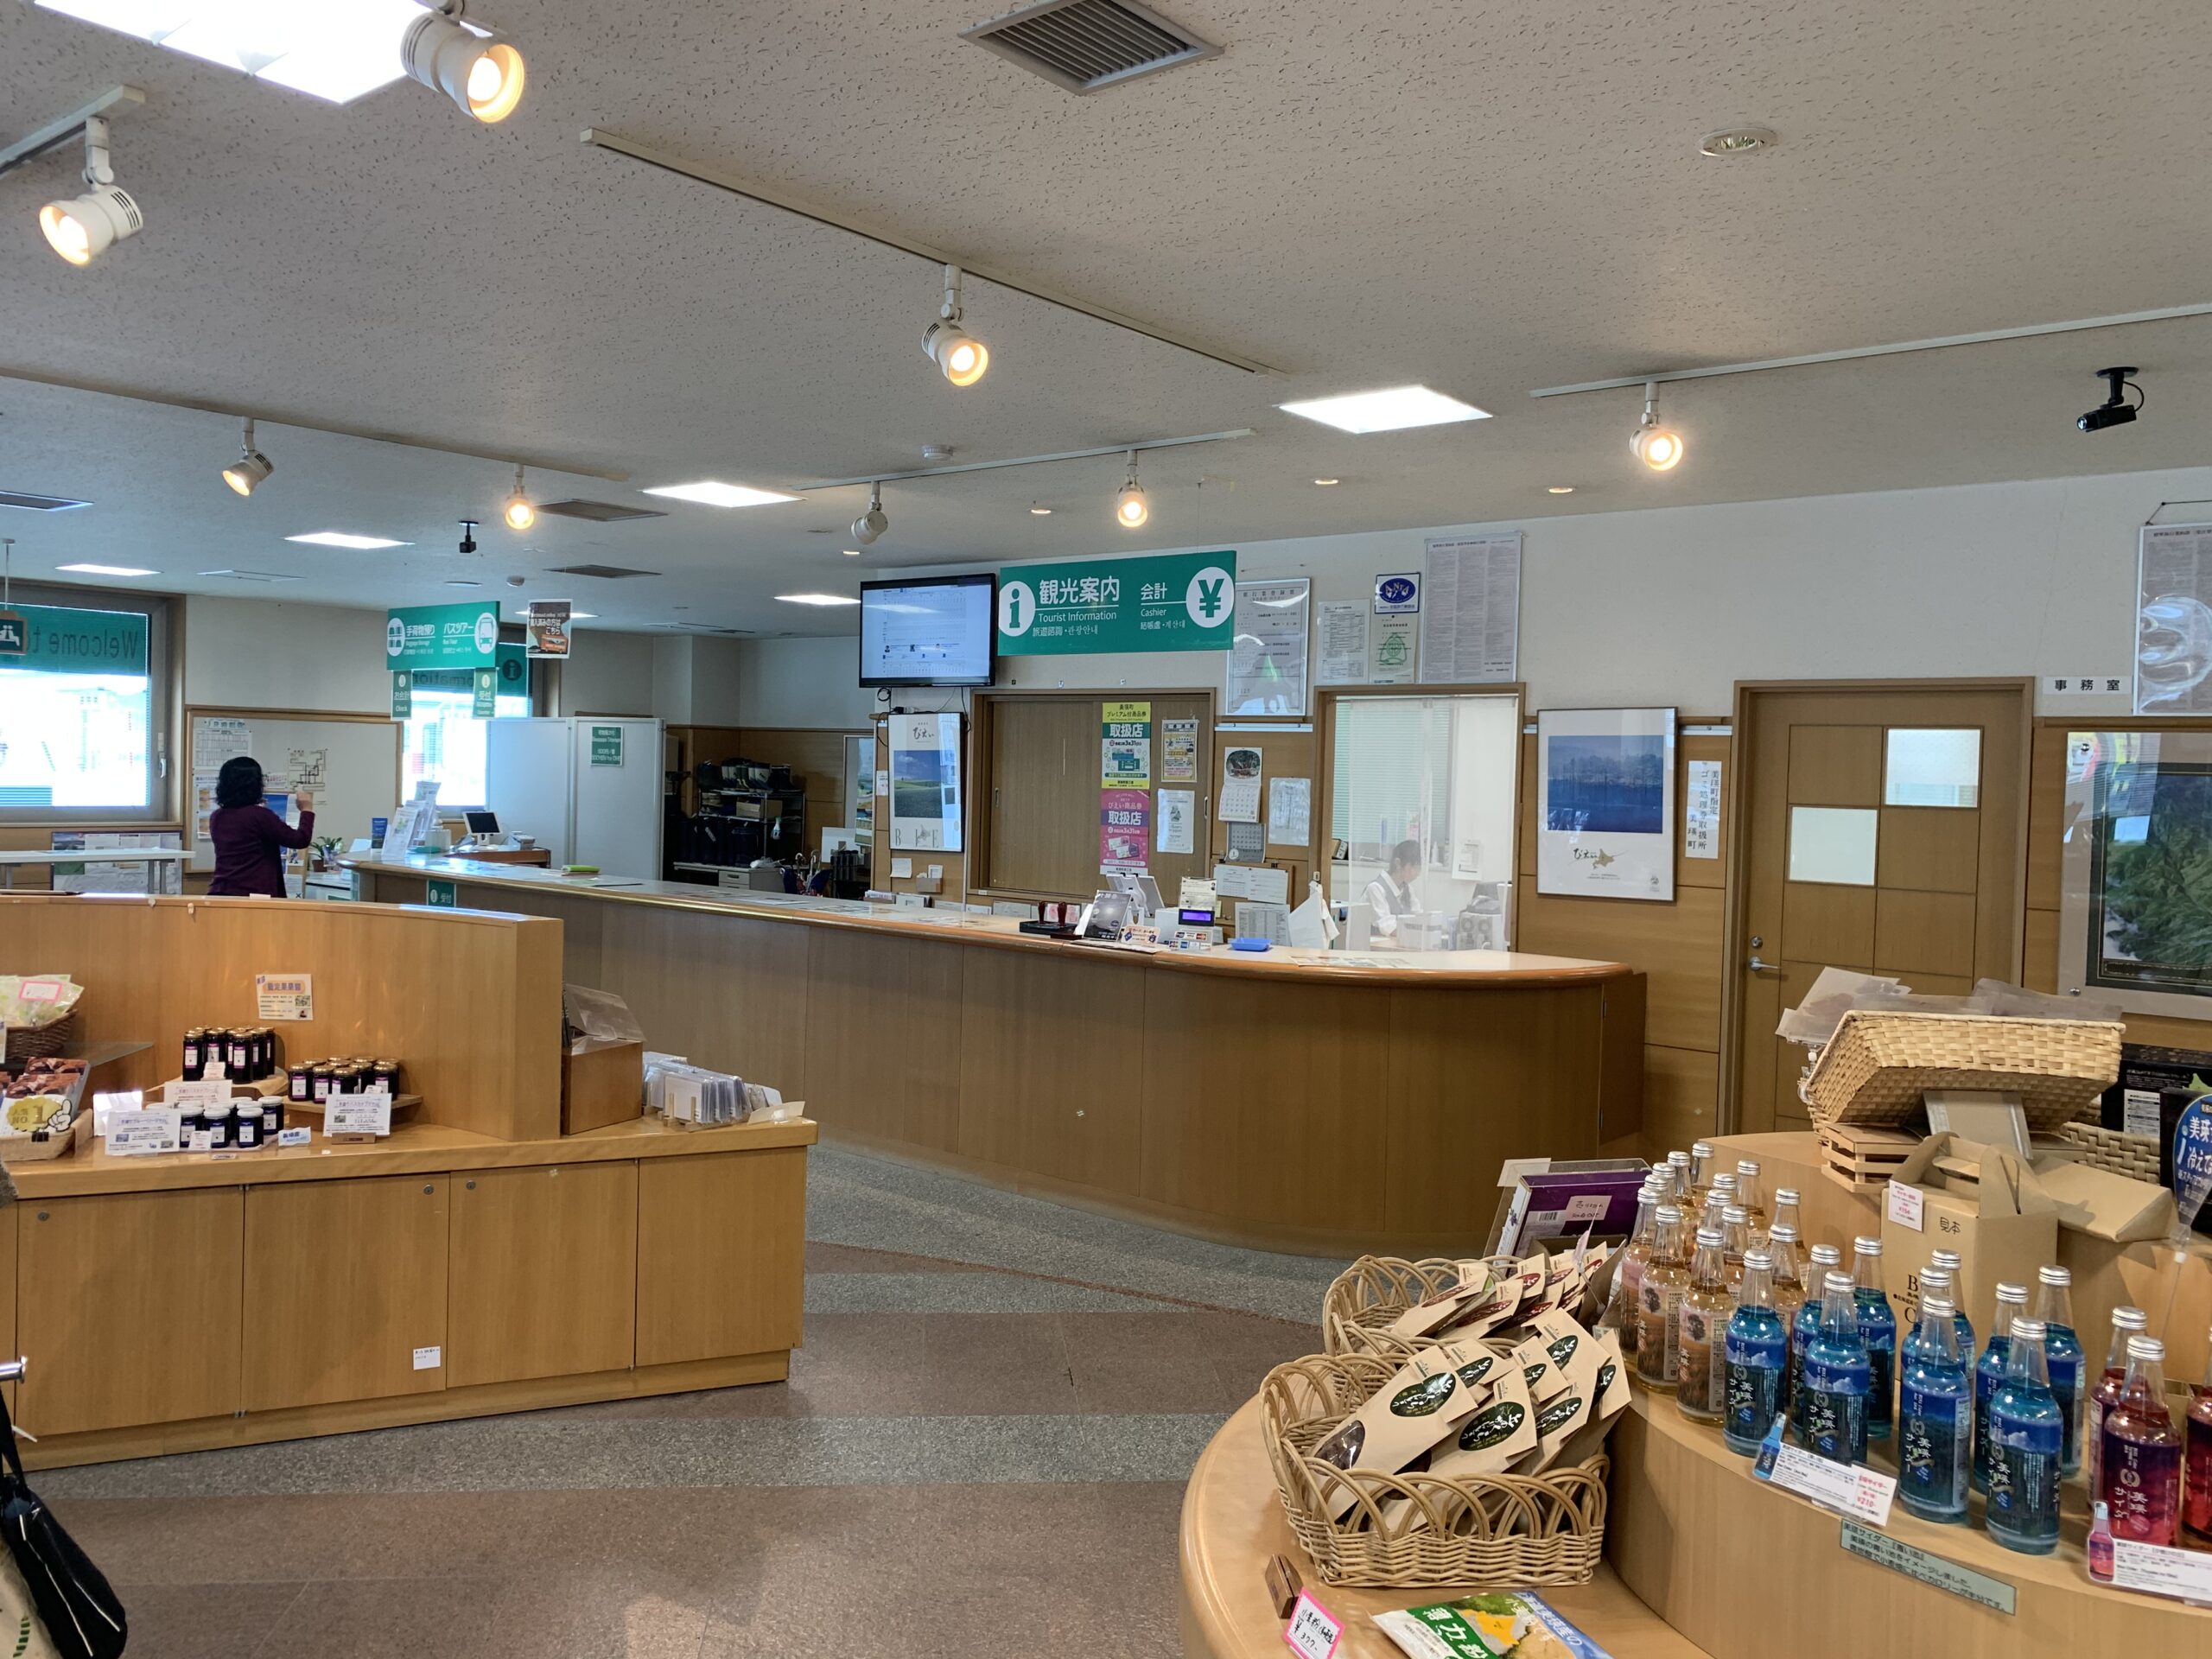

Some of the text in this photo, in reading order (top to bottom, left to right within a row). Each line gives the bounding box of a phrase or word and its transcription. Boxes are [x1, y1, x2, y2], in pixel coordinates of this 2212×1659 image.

[1039, 575, 1120, 605] 観光案内
[1141, 582, 1167, 601] 会計
[1039, 611, 1117, 623] Tourist Information
[1141, 608, 1167, 617] Cashier
[443, 622, 474, 634] バスツアー
[2055, 679, 2120, 691] 事務室
[1109, 723, 1143, 738] 取扱店
[1108, 810, 1141, 825] 取扱店
[1688, 814, 1697, 849] 美瑛町
[2189, 1116, 2212, 1142] 美瑛
[1940, 1217, 1961, 1235] 見本
[1729, 1378, 1738, 1415] サイダー
[1808, 1405, 1819, 1443] サイダー
[1905, 1433, 1915, 1472] サイダー
[2114, 1487, 2126, 1529] サイダー
[1843, 1522, 1888, 1545] 美瑛サイダー
[1421, 1607, 1489, 1659] 薄力粉
